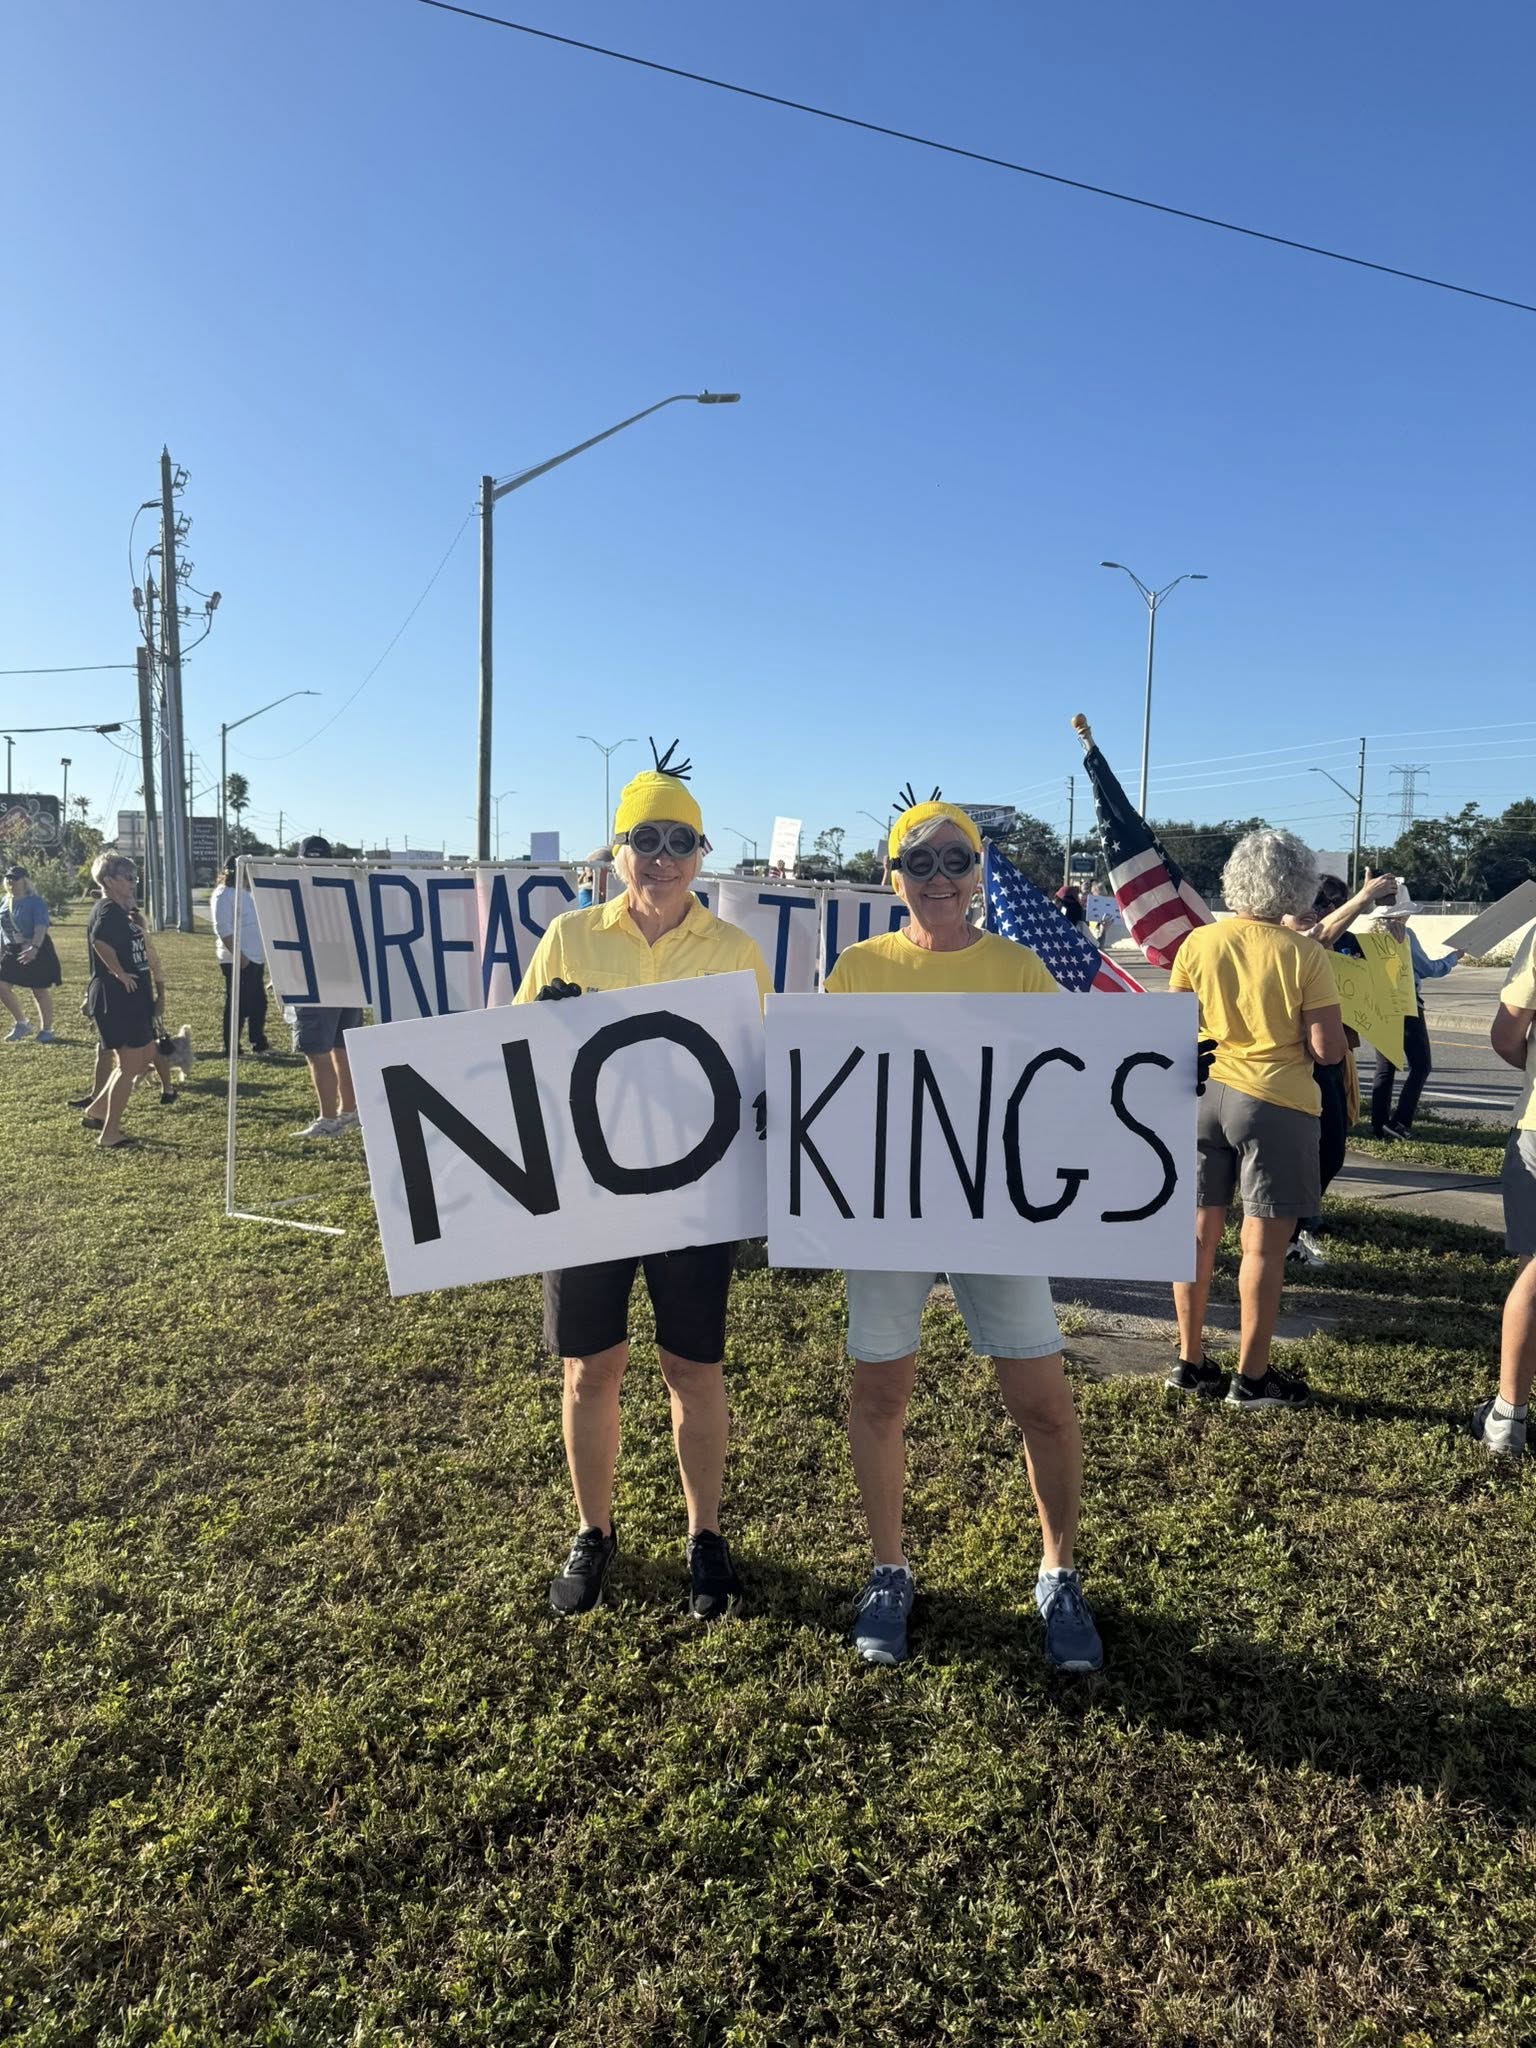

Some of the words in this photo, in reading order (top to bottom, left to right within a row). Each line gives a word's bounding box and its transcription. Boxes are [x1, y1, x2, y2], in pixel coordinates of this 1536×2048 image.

[757, 893, 911, 994] TH
[1371, 934, 1397, 957] NO
[381, 1010, 741, 1245] NO
[789, 1046, 1178, 1223] KINGS
